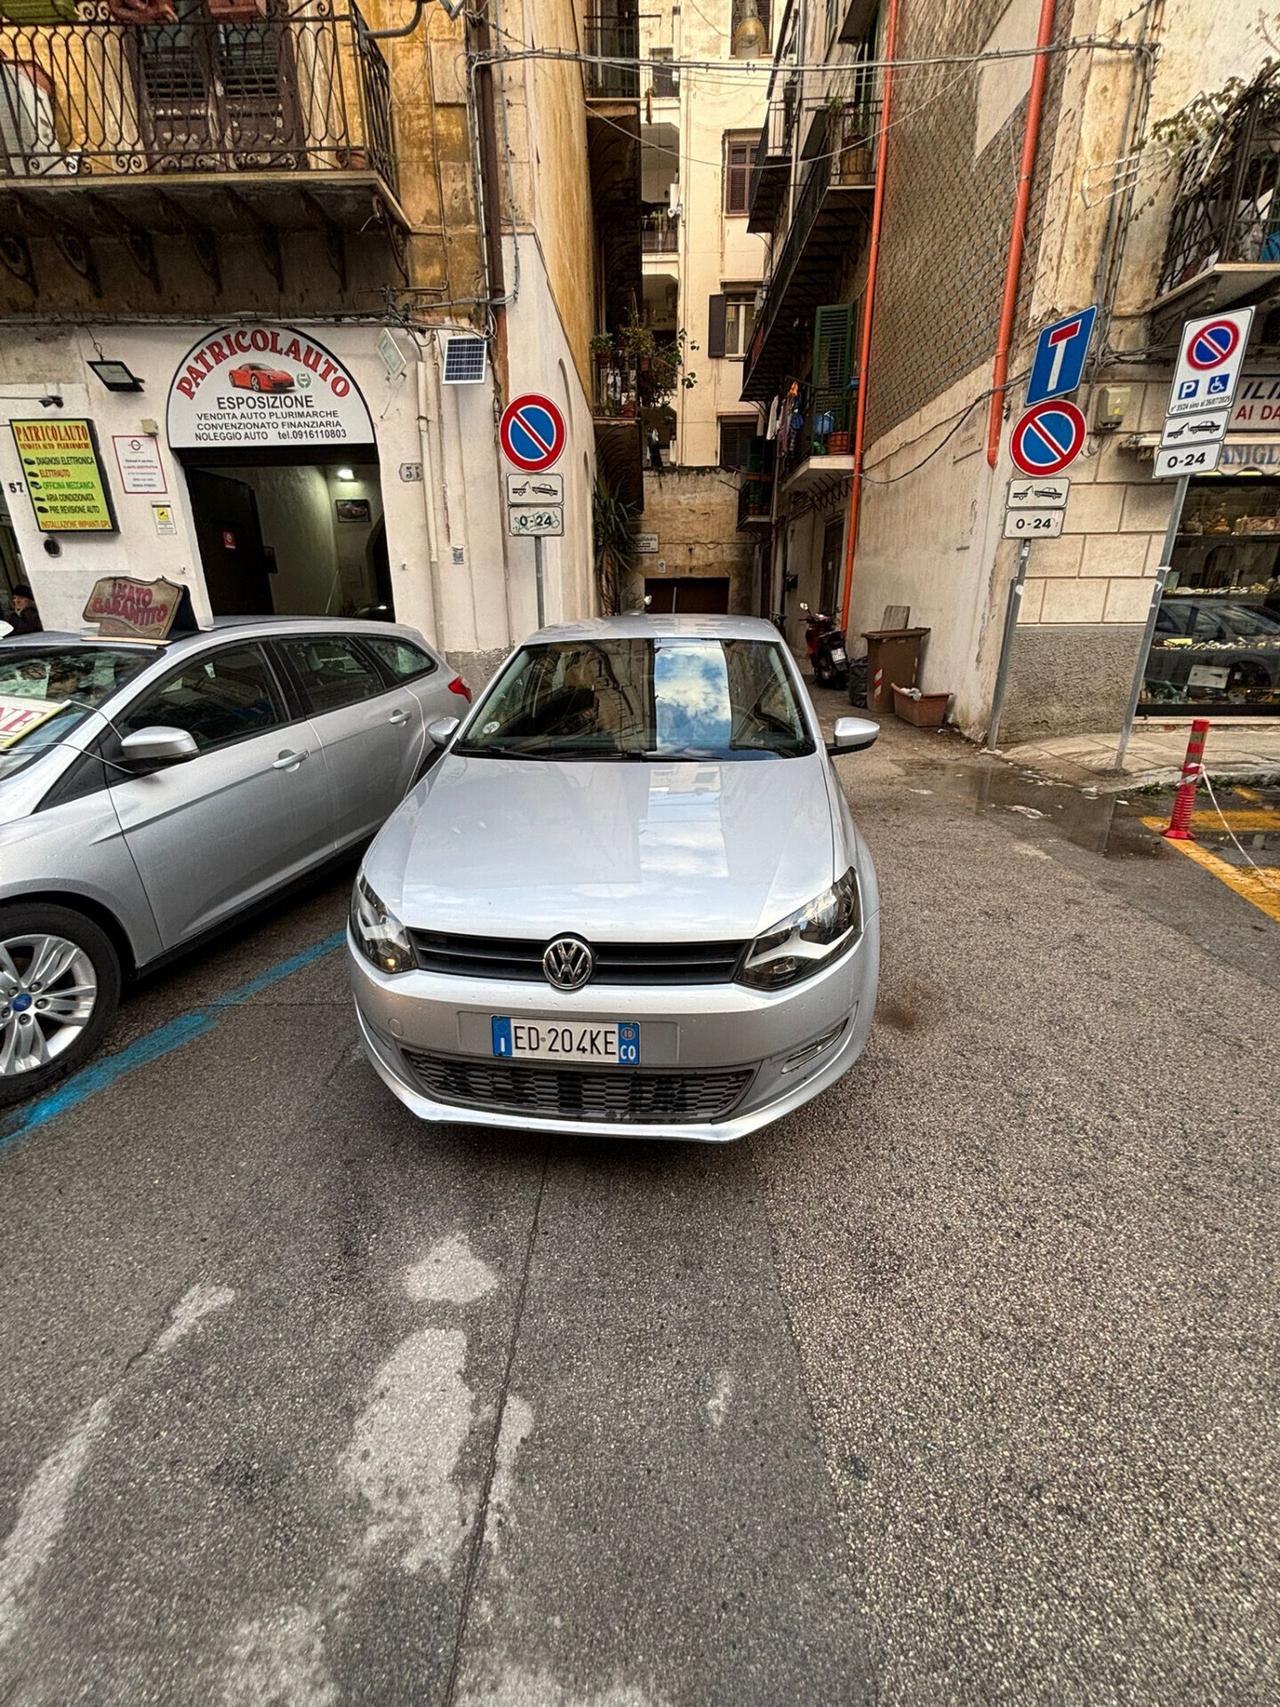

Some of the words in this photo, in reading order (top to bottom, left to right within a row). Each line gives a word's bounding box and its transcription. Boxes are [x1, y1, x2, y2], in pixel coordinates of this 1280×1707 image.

[176, 329, 351, 400] PATRICOLAUTO
[217, 395, 315, 411] ESPOSIZIONE
[196, 412, 238, 421] VENDITA
[240, 411, 267, 420] AUTO
[269, 410, 339, 420] PLURIMARCHE
[197, 422, 279, 431] CONVENZIONATO
[281, 420, 342, 430] FINANZIARIA
[15, 425, 89, 442] PATRICOLAUTO
[195, 431, 242, 441] NOLEGGIO
[244, 431, 268, 440] AUTO
[278, 428, 347, 440] tel.0916110803
[36, 457, 60, 465] DIAGNOSI
[61, 457, 95, 465] ELETTRONICA
[1167, 452, 1206, 469] 0-24
[9, 482, 24, 493] 57
[49, 506, 60, 514] PRE
[61, 506, 86, 514] REVISIONE
[87, 506, 99, 514] AUTO
[42, 521, 77, 529] INSTALLAZIONE
[1016, 518, 1052, 529] 0-24
[112, 583, 153, 608] USATO
[92, 597, 168, 626] GARANTITO
[620, 1045, 636, 1060] CO
